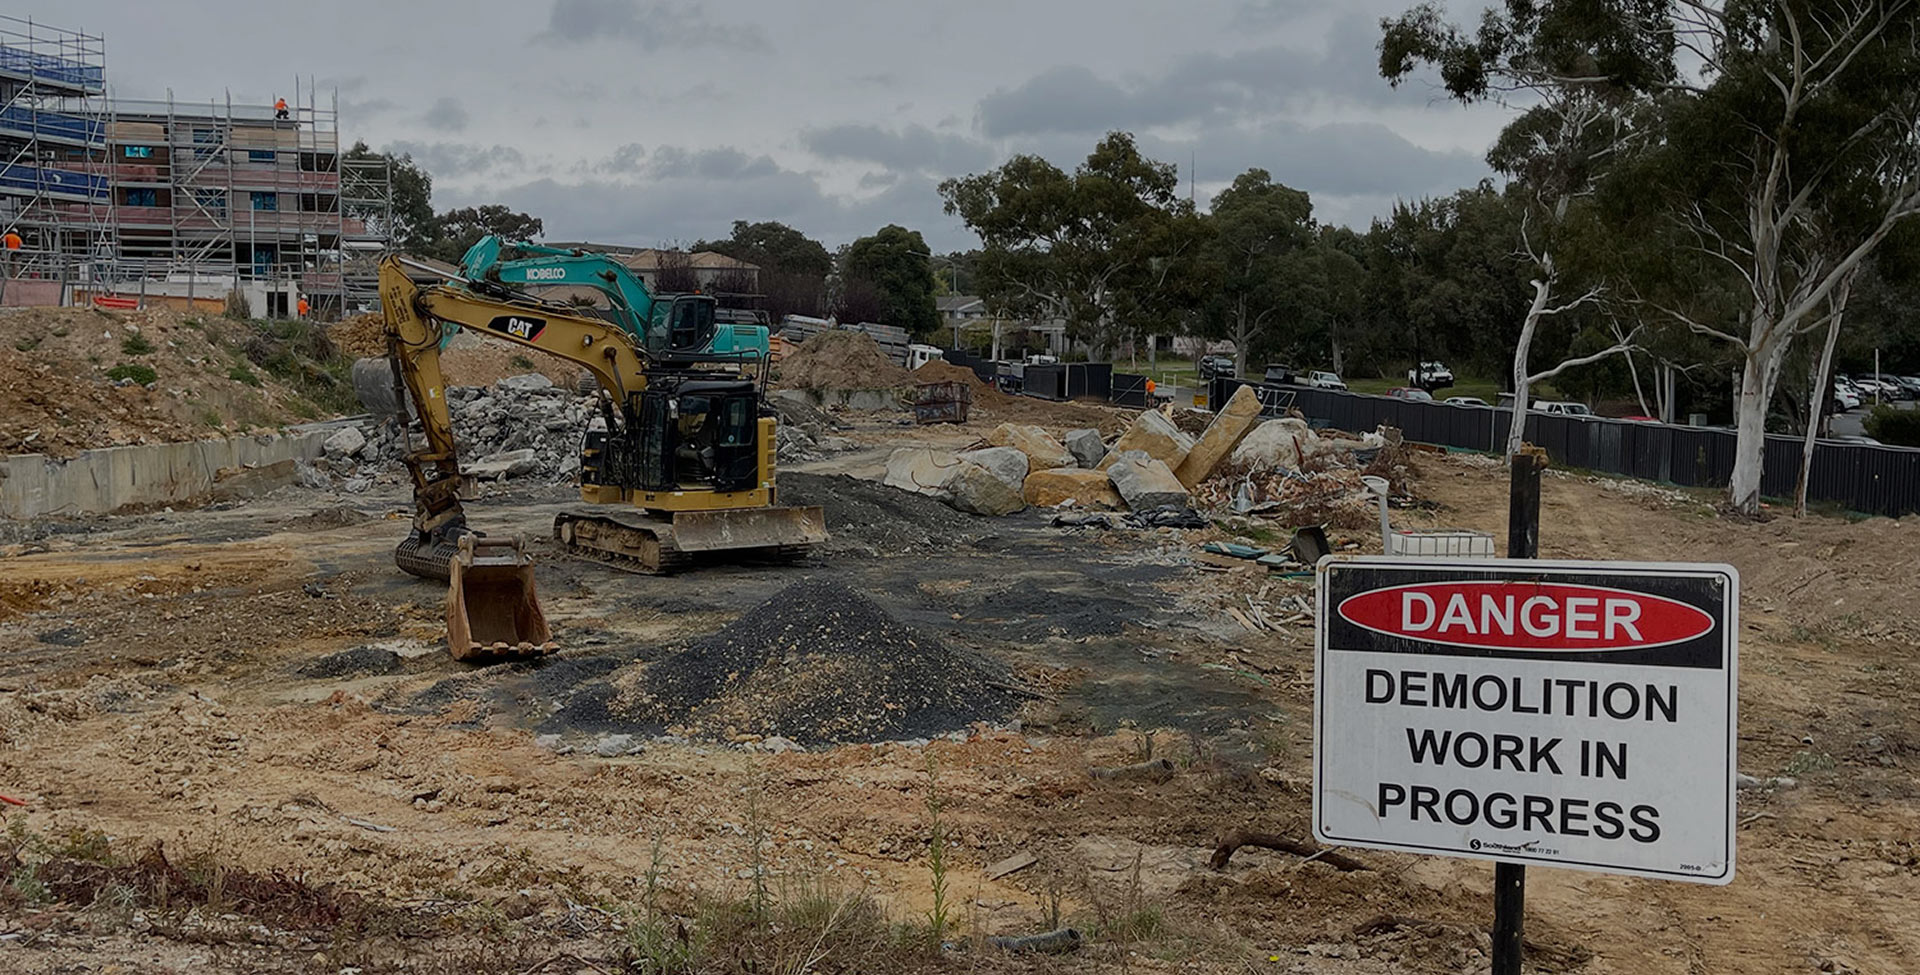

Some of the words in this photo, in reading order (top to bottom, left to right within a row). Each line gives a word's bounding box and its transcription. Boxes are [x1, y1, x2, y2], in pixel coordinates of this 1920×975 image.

[526, 267, 566, 281] KOBELCO
[507, 317, 533, 339] CAT
[1401, 591, 1644, 642] DANGER
[1365, 668, 1679, 724] DEMOLITION
[1406, 727, 1563, 777] WORK
[1580, 740, 1627, 780] IN
[1378, 782, 1661, 844] PROGRESS
